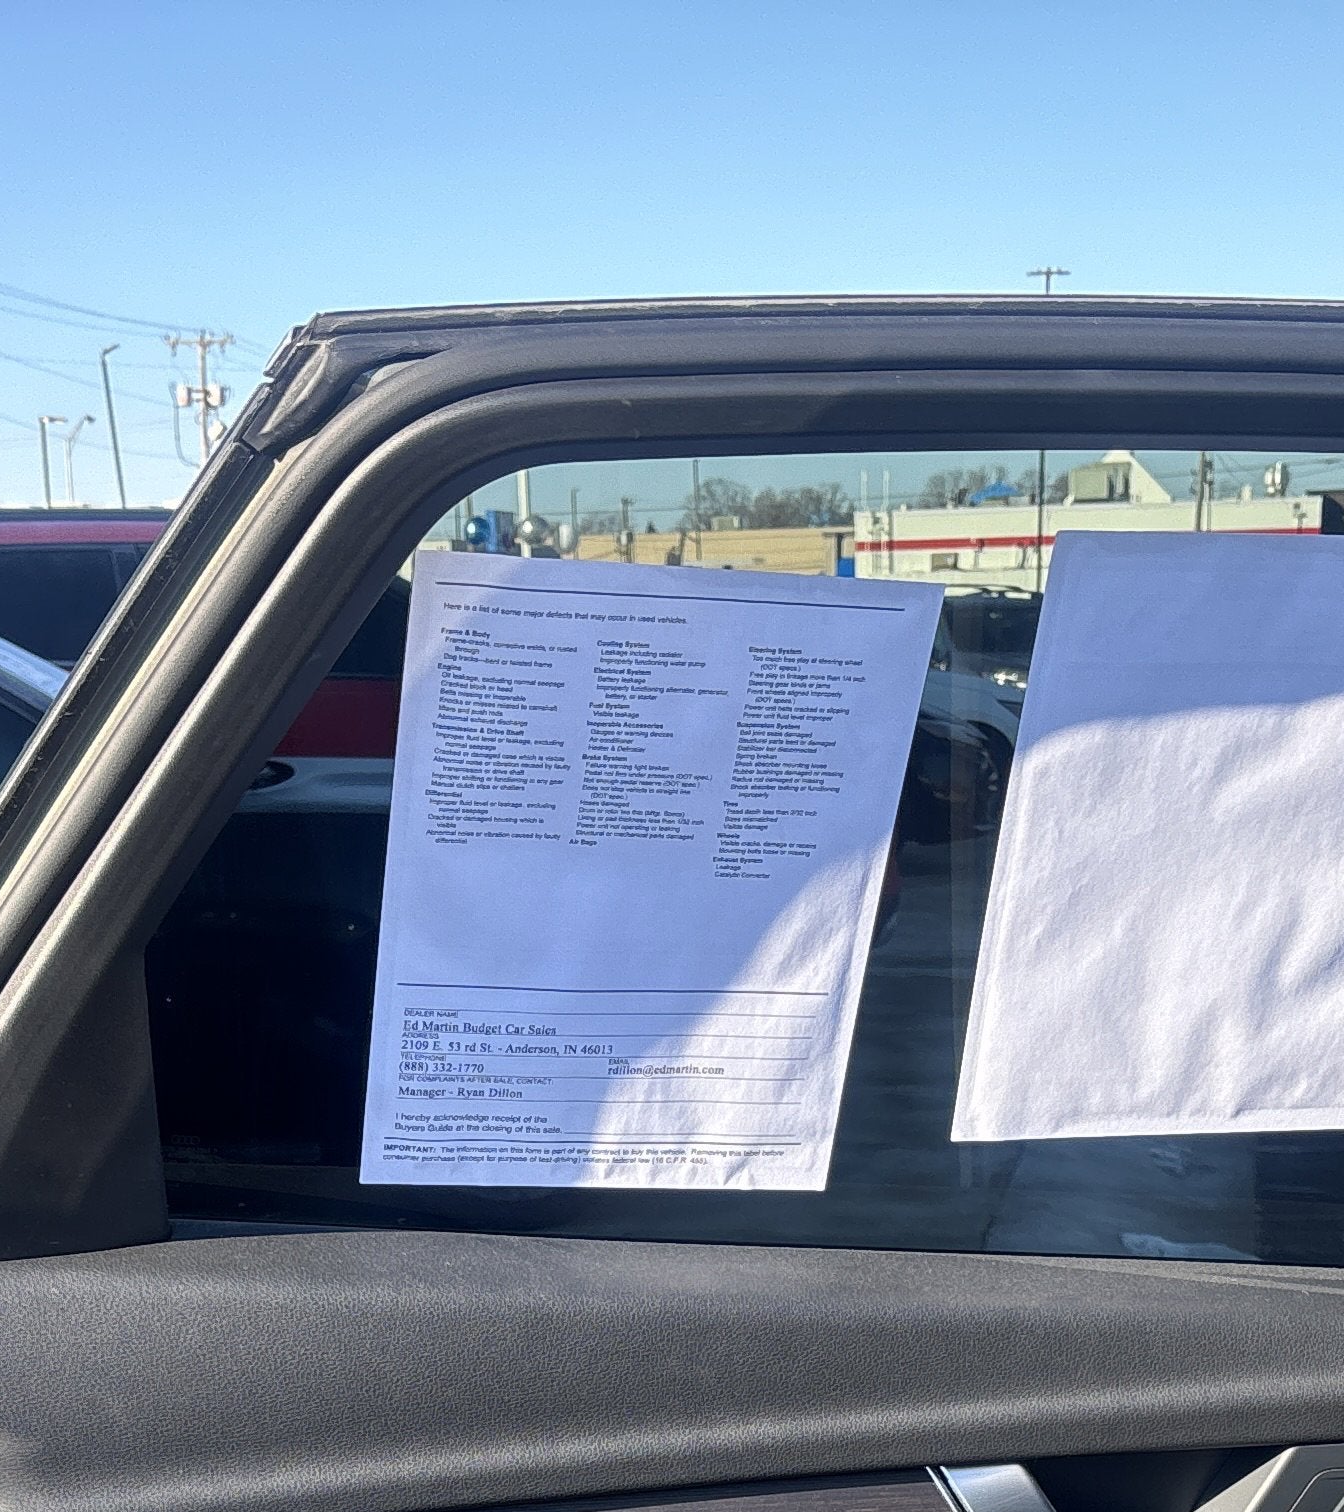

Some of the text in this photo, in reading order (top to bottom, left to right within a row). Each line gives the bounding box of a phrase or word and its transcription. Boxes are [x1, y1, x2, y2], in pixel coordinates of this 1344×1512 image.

[402, 1020, 419, 1030] Ed
[421, 1021, 460, 1032] Martin
[461, 1022, 503, 1036] Budget
[504, 1024, 526, 1034] Car
[401, 1041, 430, 1050] 2109
[447, 1042, 462, 1051] 53
[464, 1042, 477, 1051] rd
[504, 1043, 562, 1055] Anderson,
[562, 1045, 578, 1053] IN
[579, 1045, 615, 1054] 46013
[398, 1061, 485, 1073] (888) 332-1770
[607, 1065, 725, 1076] rdillon@edmartin.com
[396, 1087, 447, 1098] Manager
[456, 1088, 486, 1099] Ryan
[487, 1088, 524, 1097] Dillon
